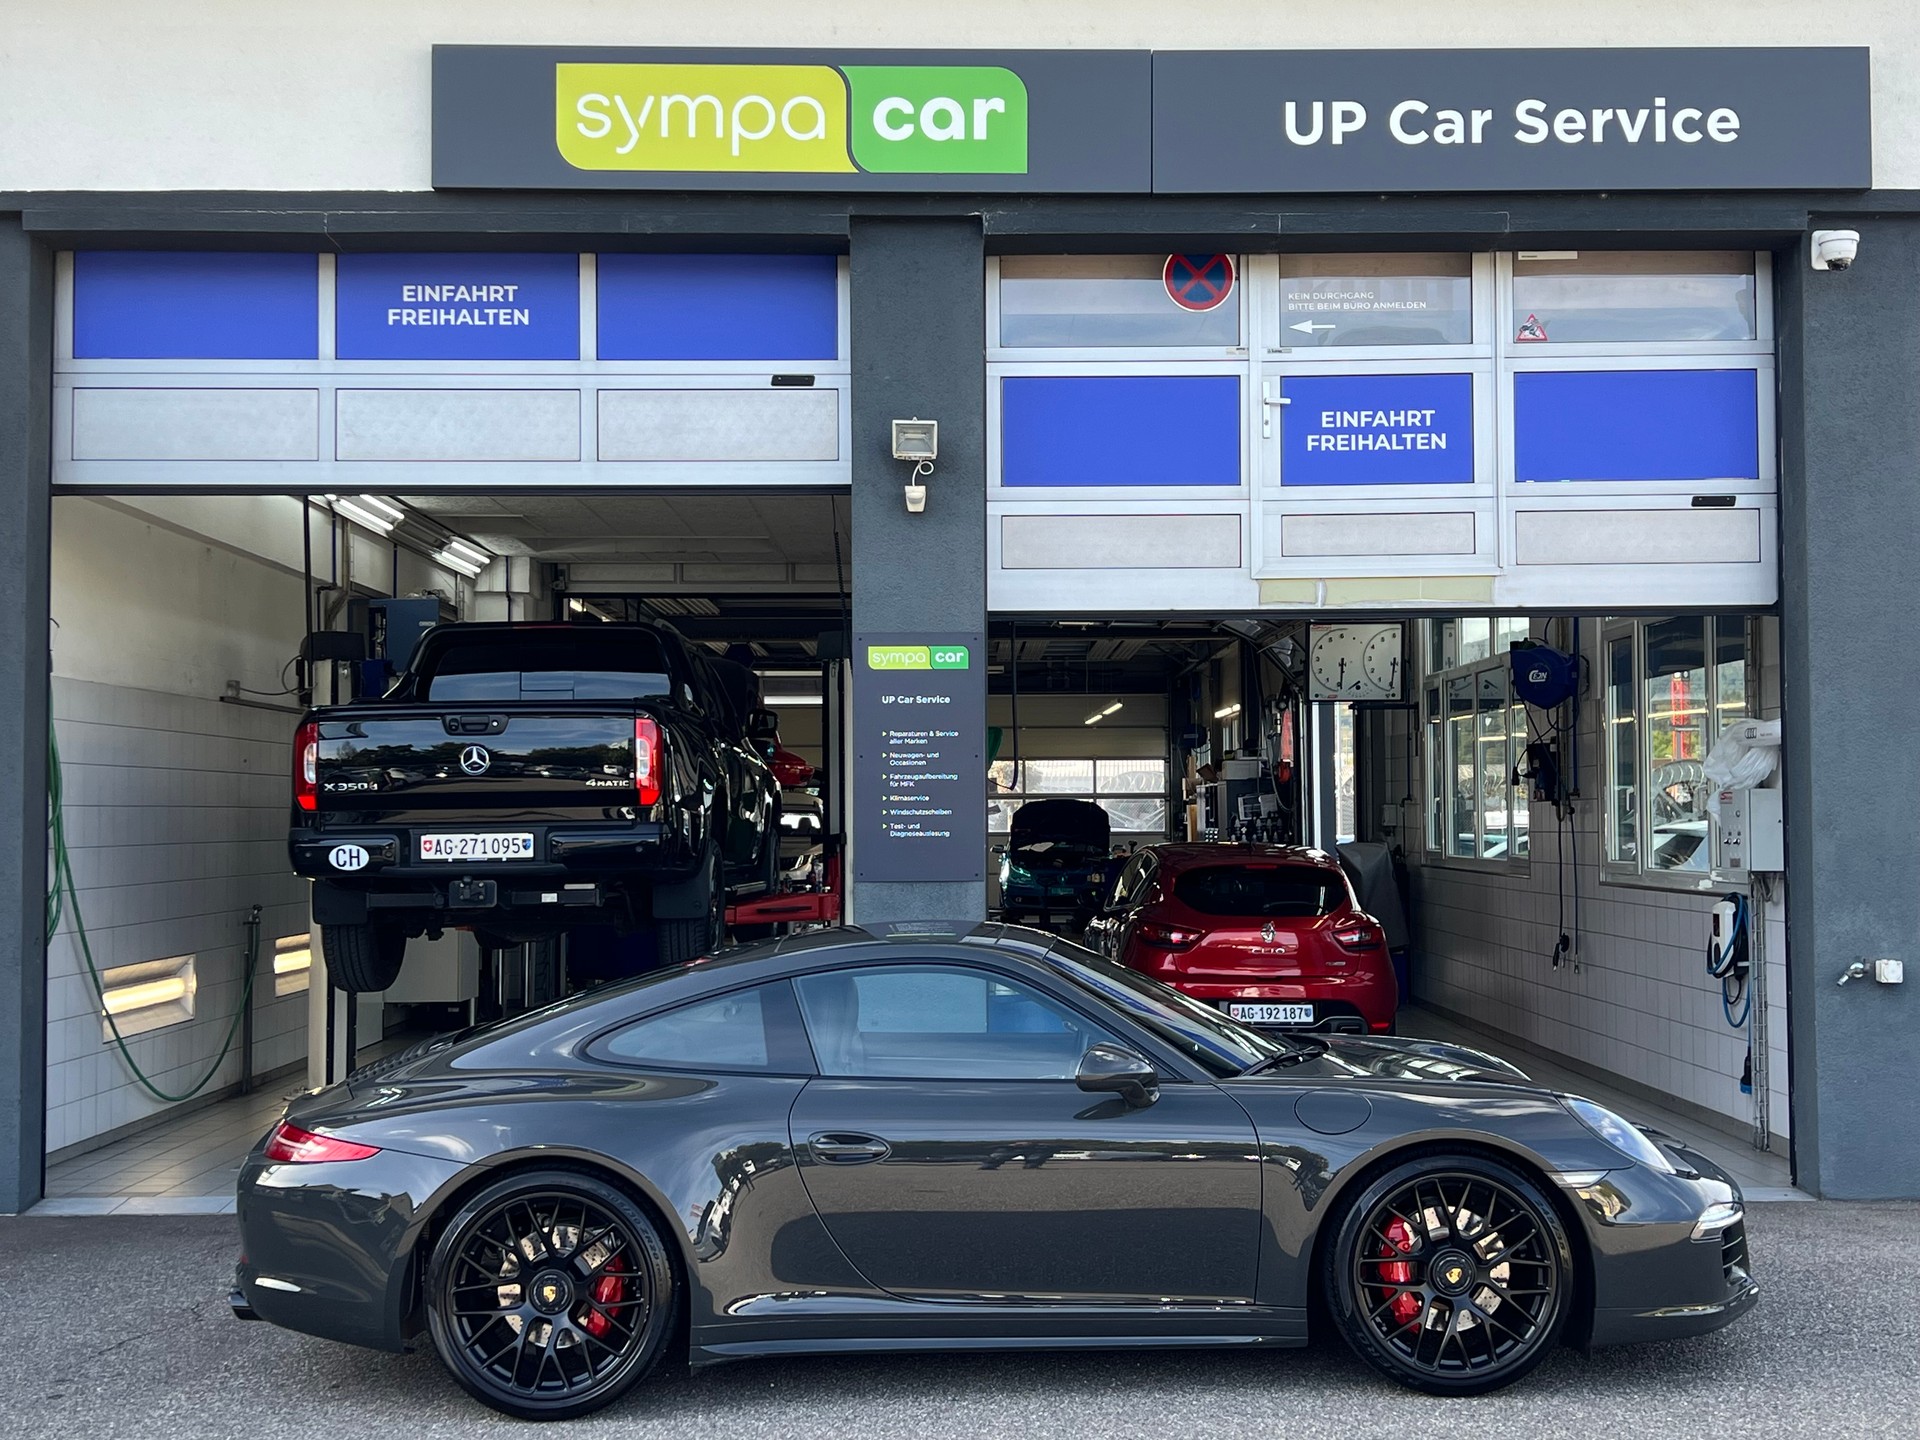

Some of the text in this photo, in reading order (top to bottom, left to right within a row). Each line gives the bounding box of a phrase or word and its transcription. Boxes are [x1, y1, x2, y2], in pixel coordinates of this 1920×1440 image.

[576, 92, 1006, 156] sympa car
[1285, 96, 1740, 146] UP Car Service
[401, 285, 519, 303] EINFAHRT
[1288, 291, 1374, 301] KEIN DURCHGANG
[1288, 300, 1427, 311] BITTE BEIM BÜRO ANMELDEN
[386, 308, 530, 327] FREIHALTEN
[1320, 409, 1436, 428] EINFAHRT
[1306, 432, 1447, 452] FREIHALTEN
[872, 651, 964, 666] sympa car
[881, 694, 951, 704] UP Car Service
[889, 730, 928, 739] Reparaturen
[335, 848, 362, 867] CH
[1251, 947, 1286, 955] CLIO
